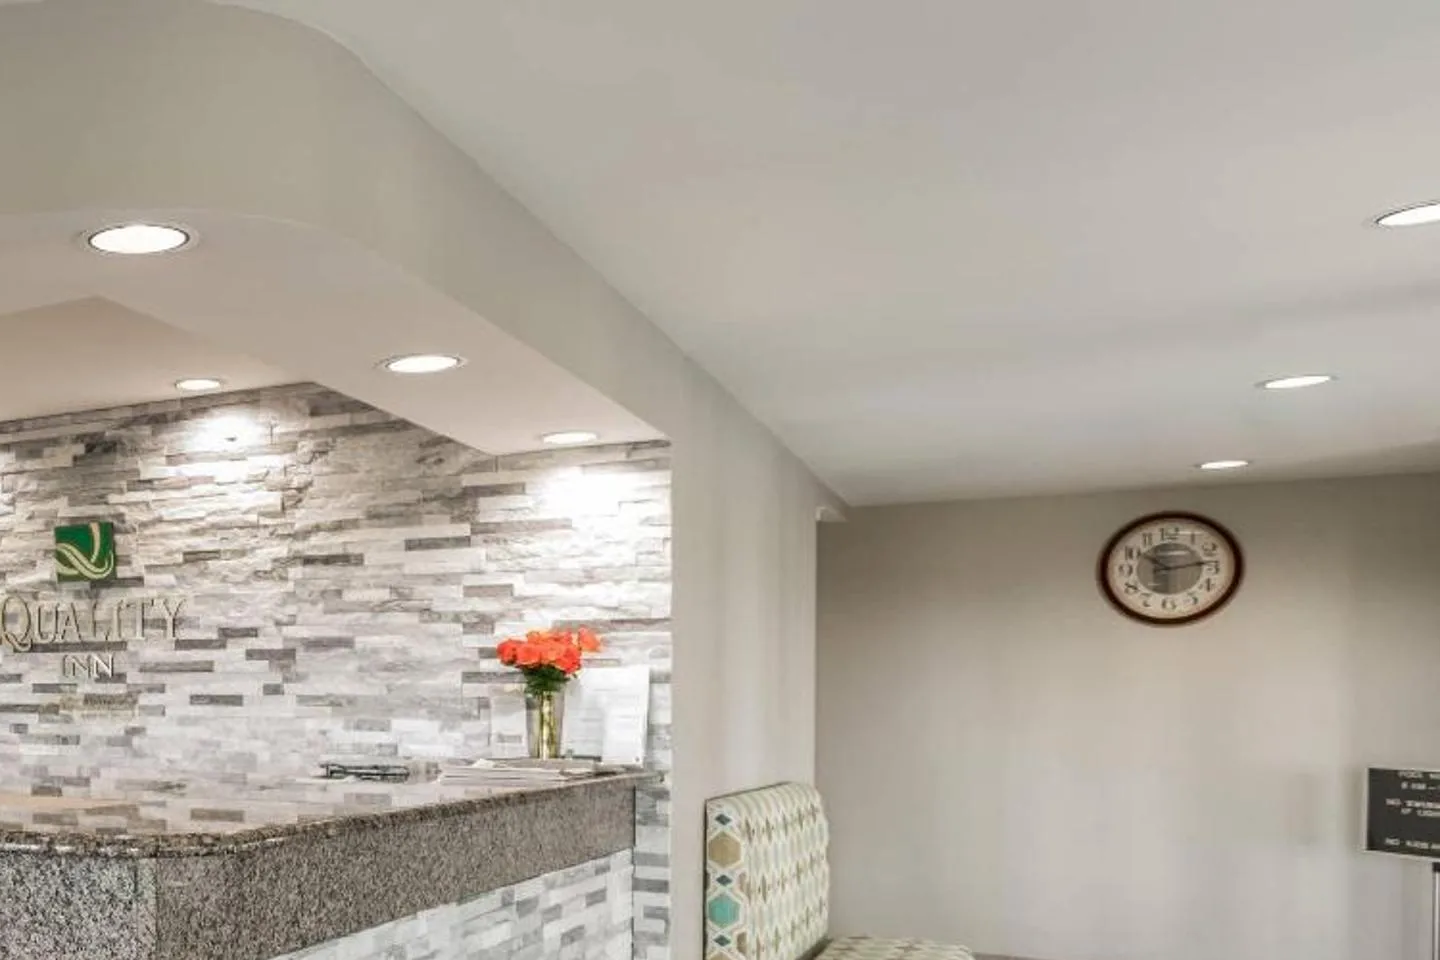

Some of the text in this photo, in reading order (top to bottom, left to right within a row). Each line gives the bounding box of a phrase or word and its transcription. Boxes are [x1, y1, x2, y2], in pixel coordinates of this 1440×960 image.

[1142, 532, 1153, 546] 11
[1160, 526, 1179, 541] 12
[1125, 546, 1142, 560] 10
[0, 594, 187, 651] QUALITY
[62, 652, 116, 679] INN
